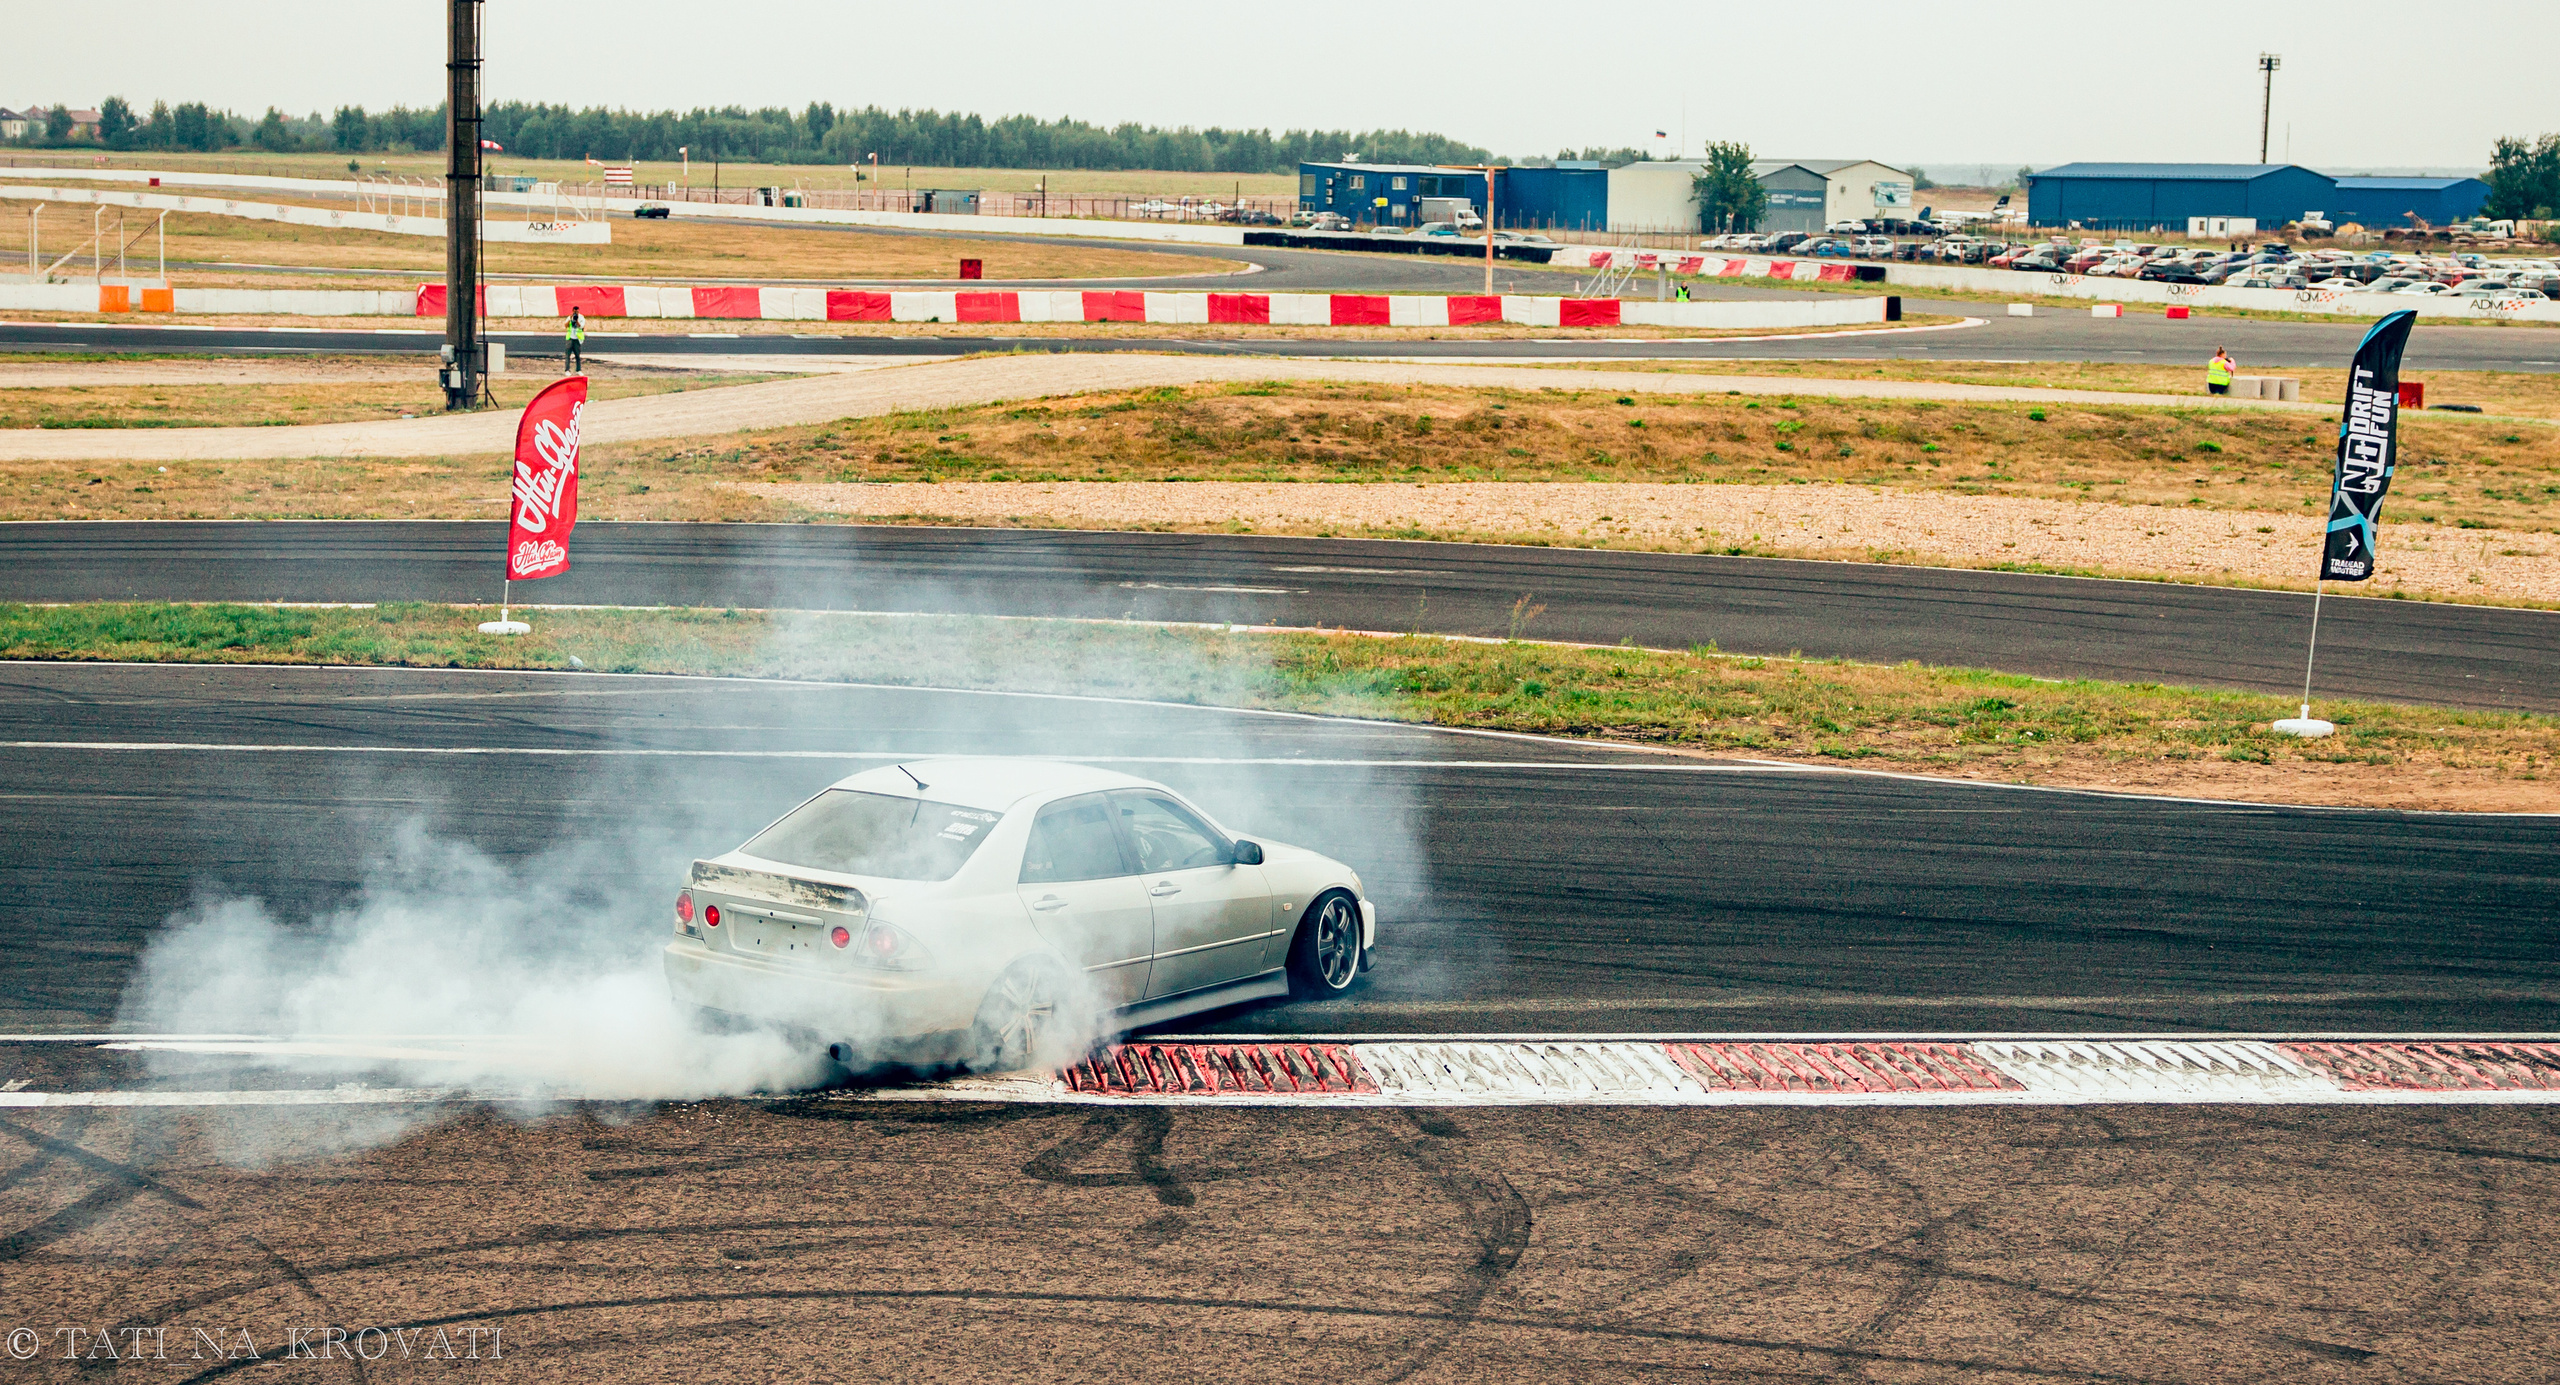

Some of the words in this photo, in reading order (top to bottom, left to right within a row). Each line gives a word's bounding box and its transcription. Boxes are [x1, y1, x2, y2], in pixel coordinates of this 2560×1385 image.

[528, 222, 553, 231] ADM
[2049, 274, 2068, 285] ADM
[2167, 284, 2187, 295] ADM
[2295, 291, 2320, 303] ADM
[2470, 299, 2504, 311] ADM
[2349, 365, 2373, 434] DRIFT
[2369, 390, 2392, 438] FUN
